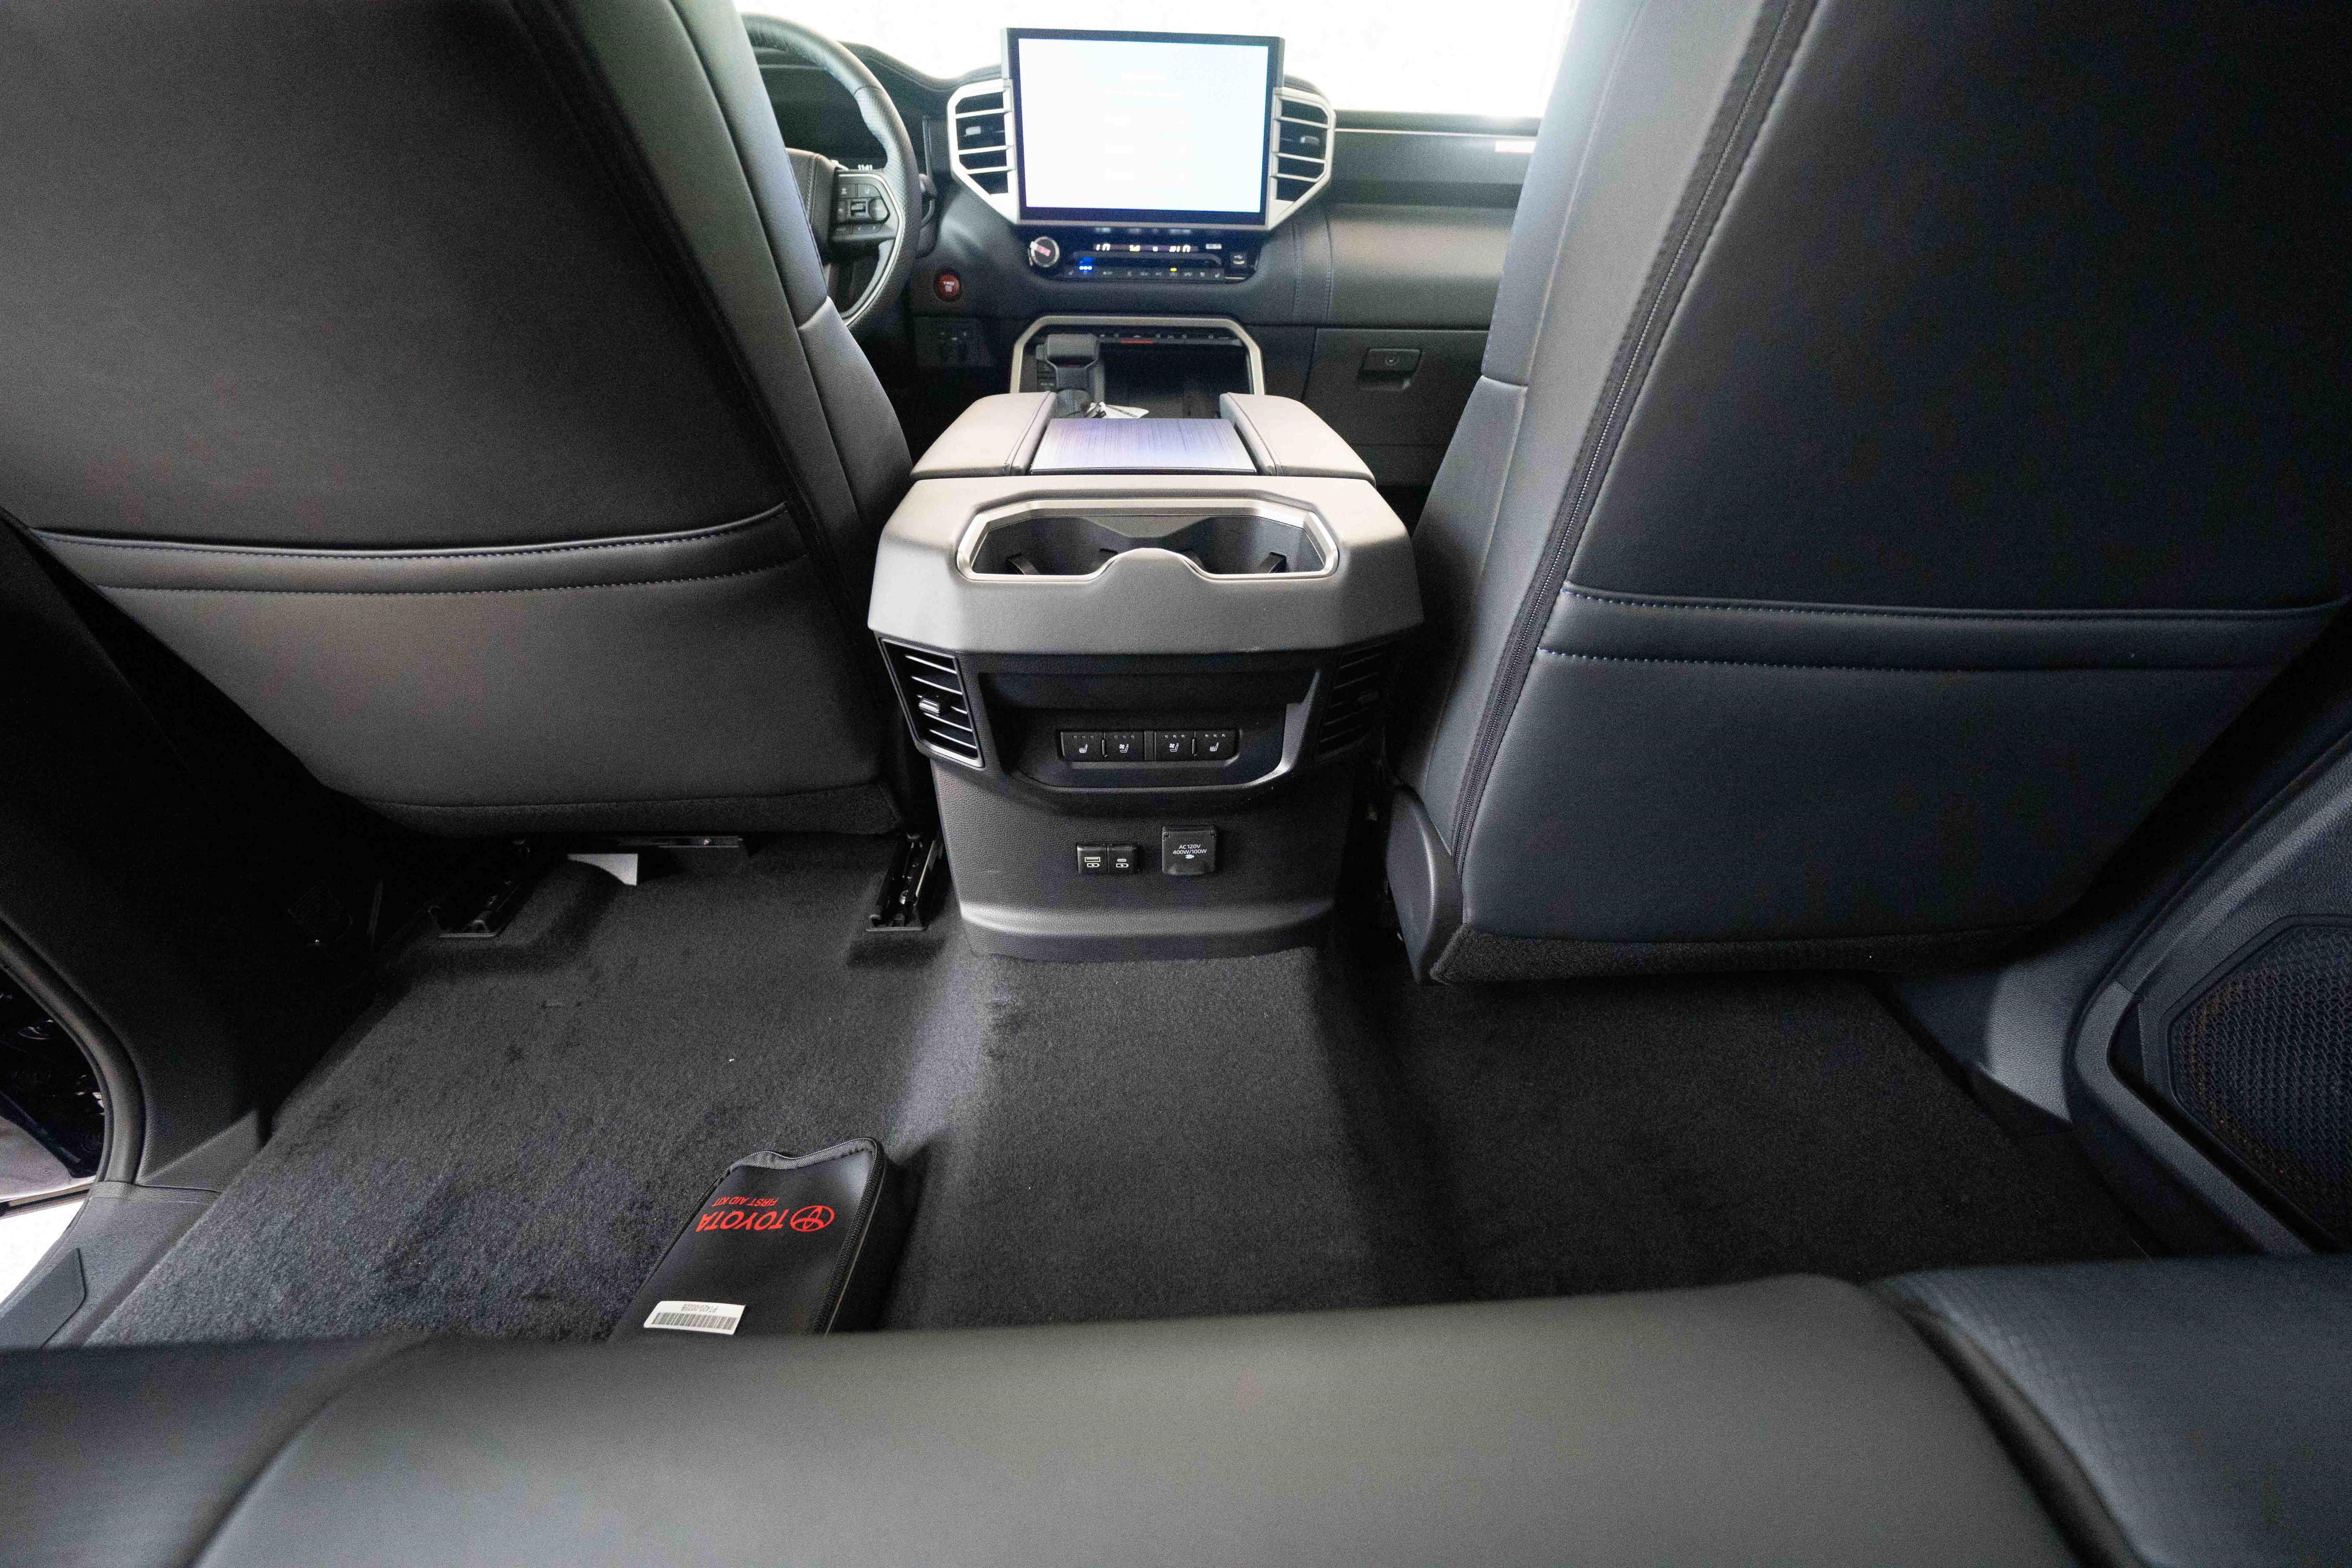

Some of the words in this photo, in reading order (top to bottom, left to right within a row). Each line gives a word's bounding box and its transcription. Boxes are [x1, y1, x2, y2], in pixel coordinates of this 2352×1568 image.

[712, 1197, 730, 1207] KIT
[729, 1196, 748, 1205] AID
[748, 1196, 779, 1207] FIRST
[695, 1209, 789, 1232] TOYOTA
